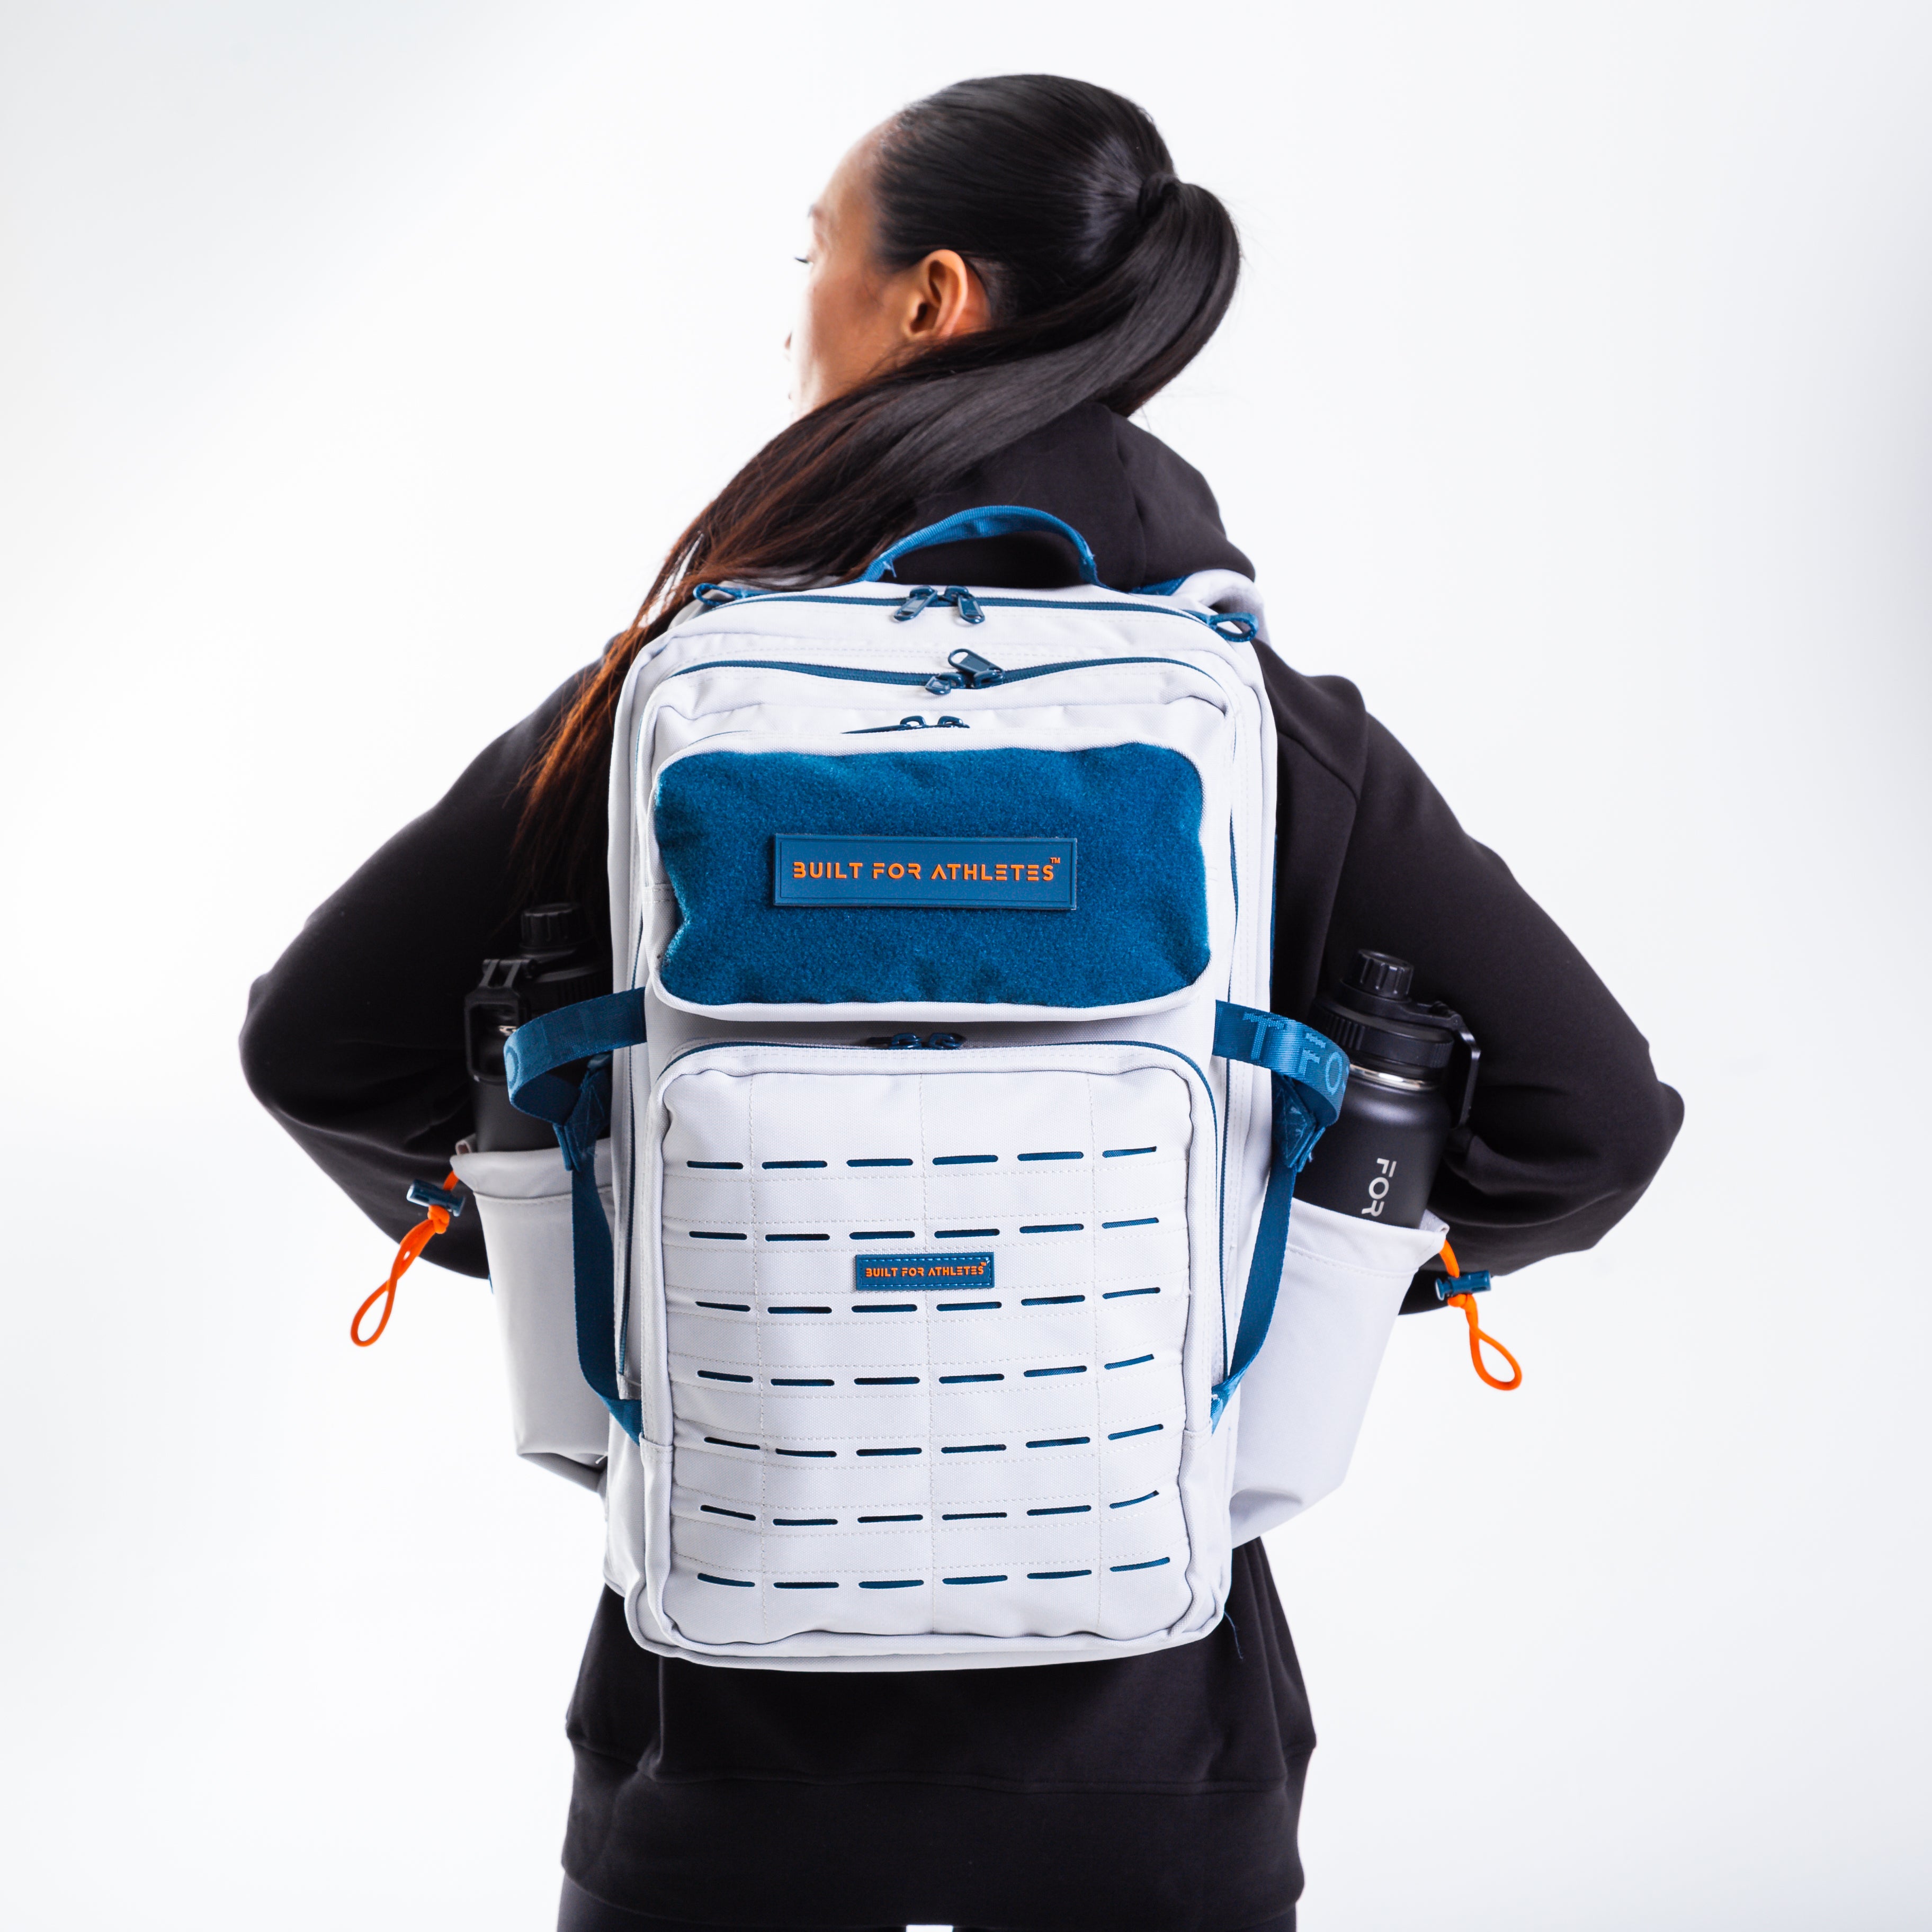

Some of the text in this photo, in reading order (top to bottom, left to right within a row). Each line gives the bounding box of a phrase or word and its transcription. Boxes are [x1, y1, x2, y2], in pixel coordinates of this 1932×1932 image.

[793, 862, 863, 879] BUILT
[873, 862, 921, 880] FOR
[1361, 1158, 1397, 1217] FOR
[865, 1267, 898, 1277] BUILT
[901, 1267, 924, 1277] FOR
